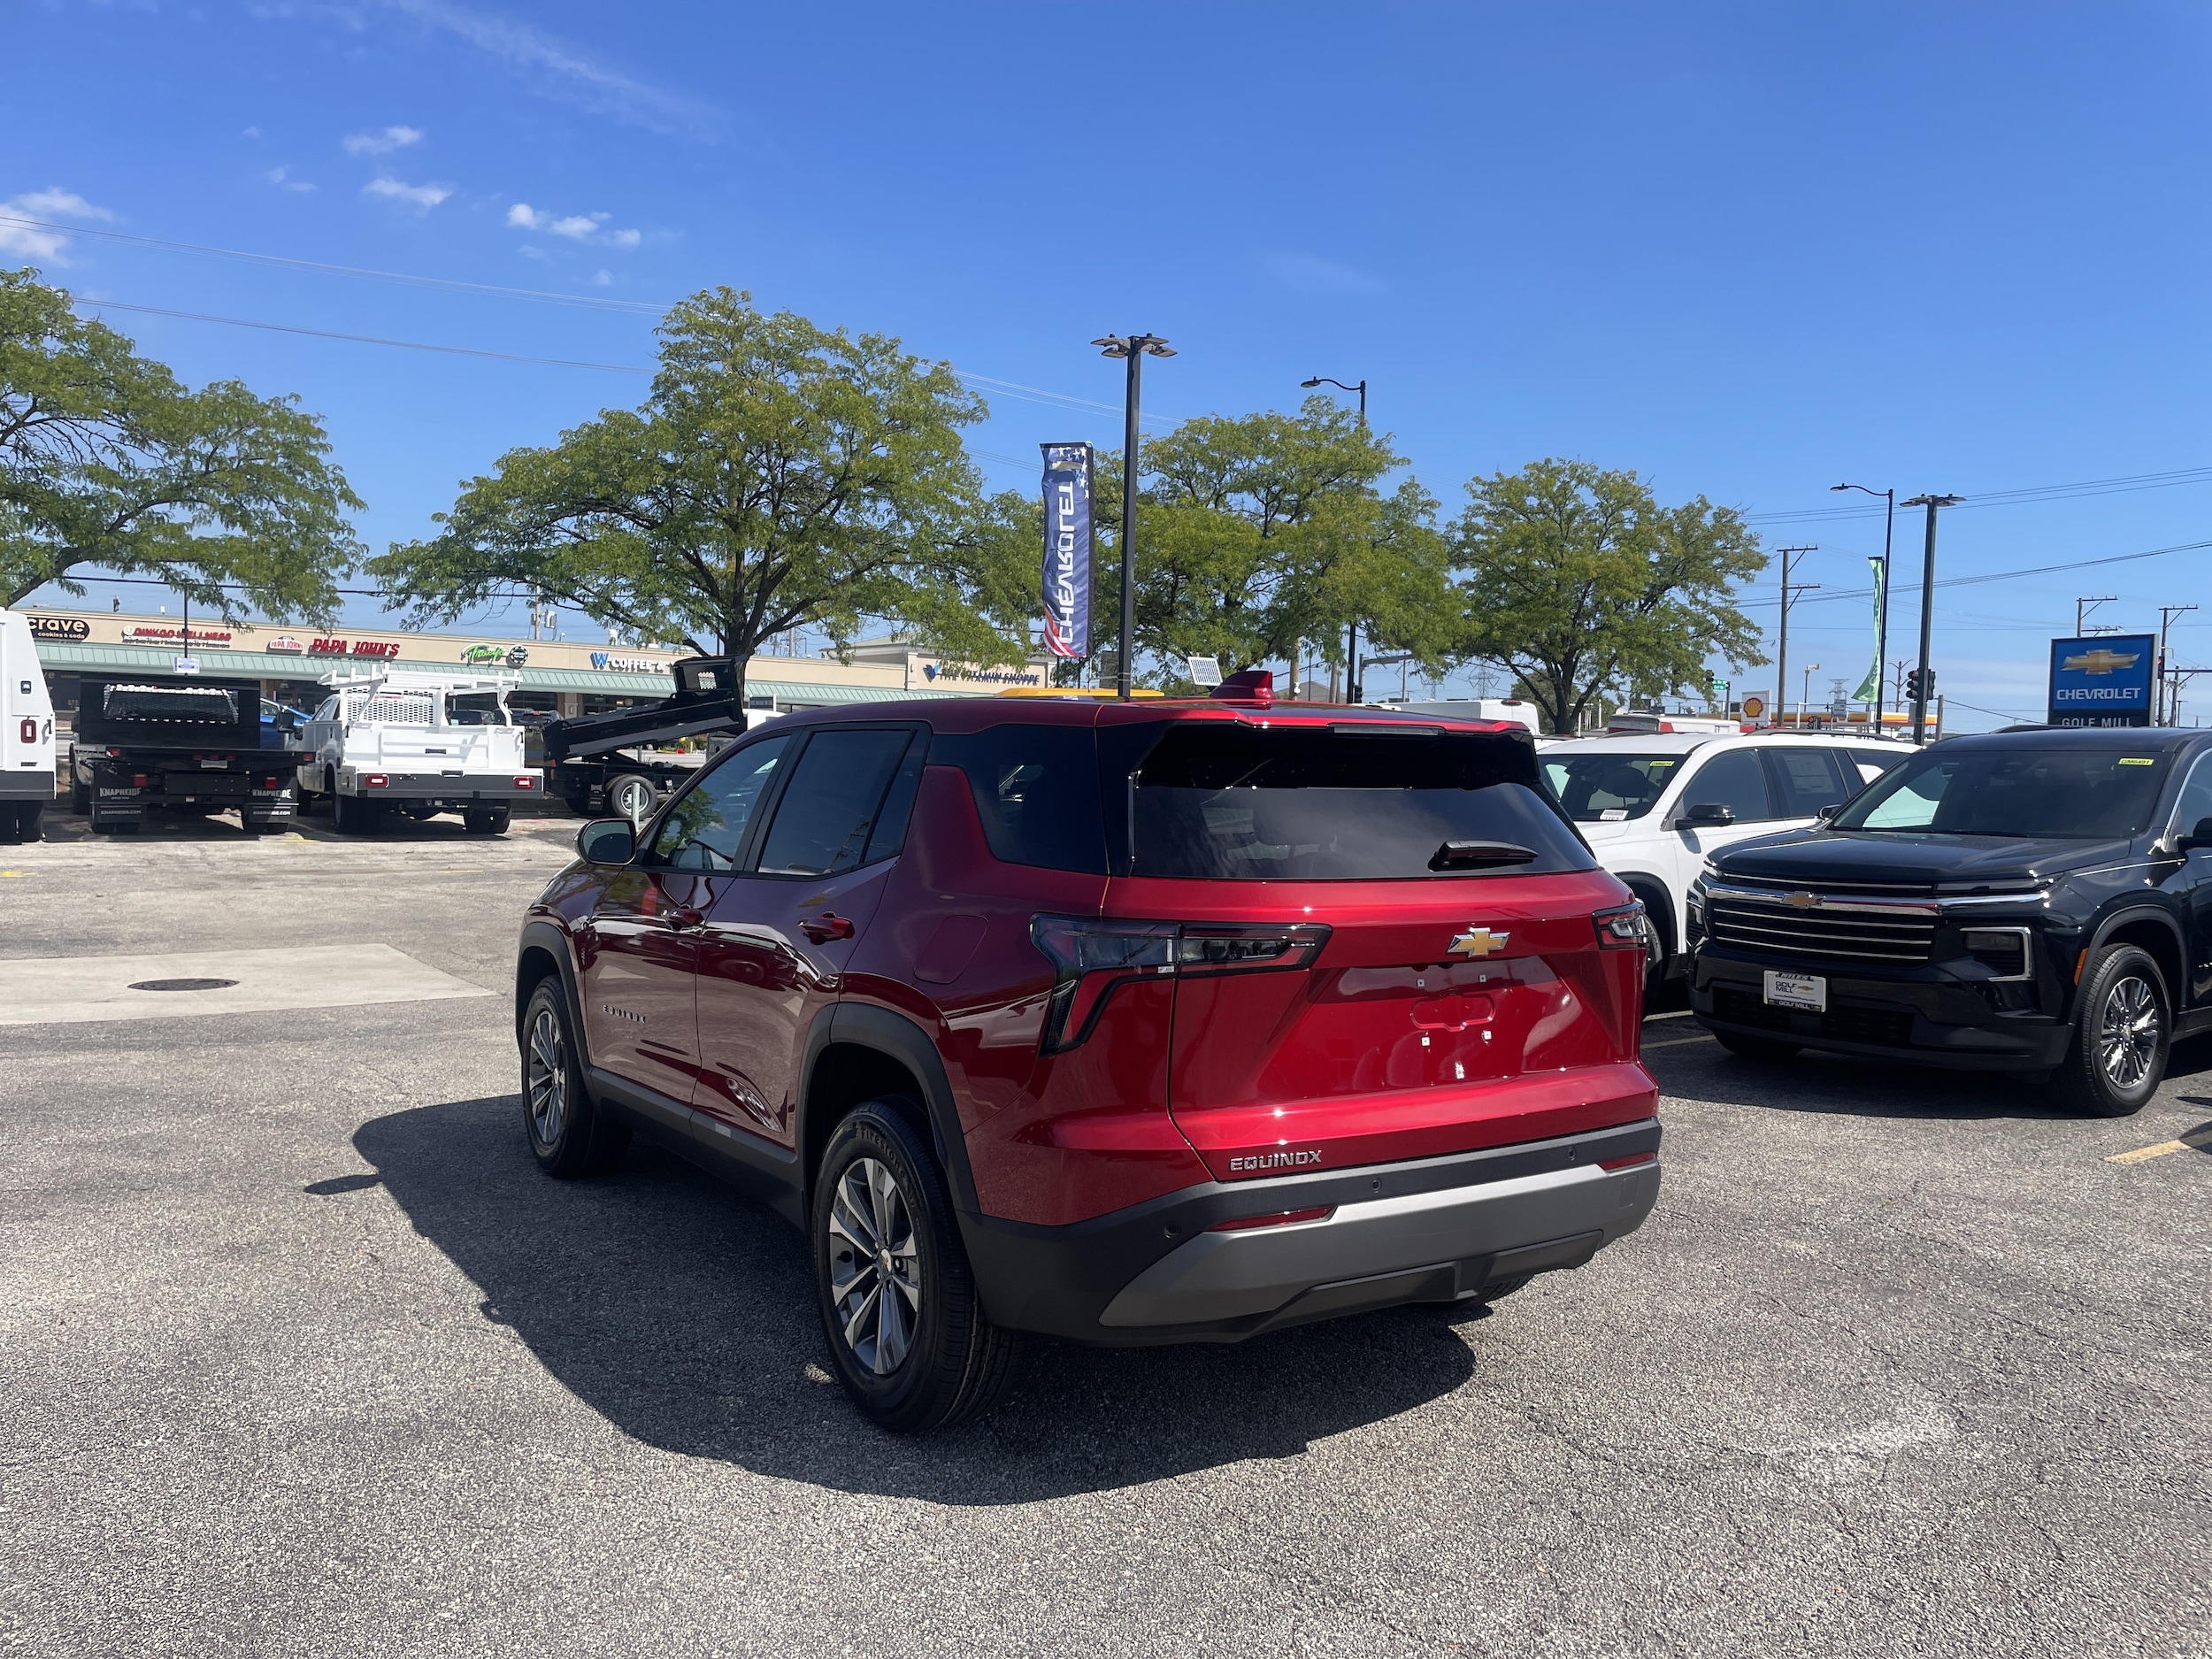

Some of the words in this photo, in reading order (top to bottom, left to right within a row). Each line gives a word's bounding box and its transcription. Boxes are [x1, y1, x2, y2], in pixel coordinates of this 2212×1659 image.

[28, 618, 85, 633] crave
[134, 627, 175, 638] GINKGO
[177, 629, 232, 641] WELLNESS
[311, 638, 348, 653] PAPA
[354, 641, 400, 657] JOHN'S
[593, 652, 609, 667] W
[611, 657, 652, 669] COFFEE
[657, 660, 665, 671] &
[1002, 672, 1041, 683] SHOPPE
[2056, 687, 2141, 701] CHEVROLET
[2062, 718, 2096, 726] GOLF
[252, 787, 292, 799] KNAPHEIDE
[603, 1004, 646, 1024] EQUINOX
[1230, 1149, 1322, 1171] EQUINOX
